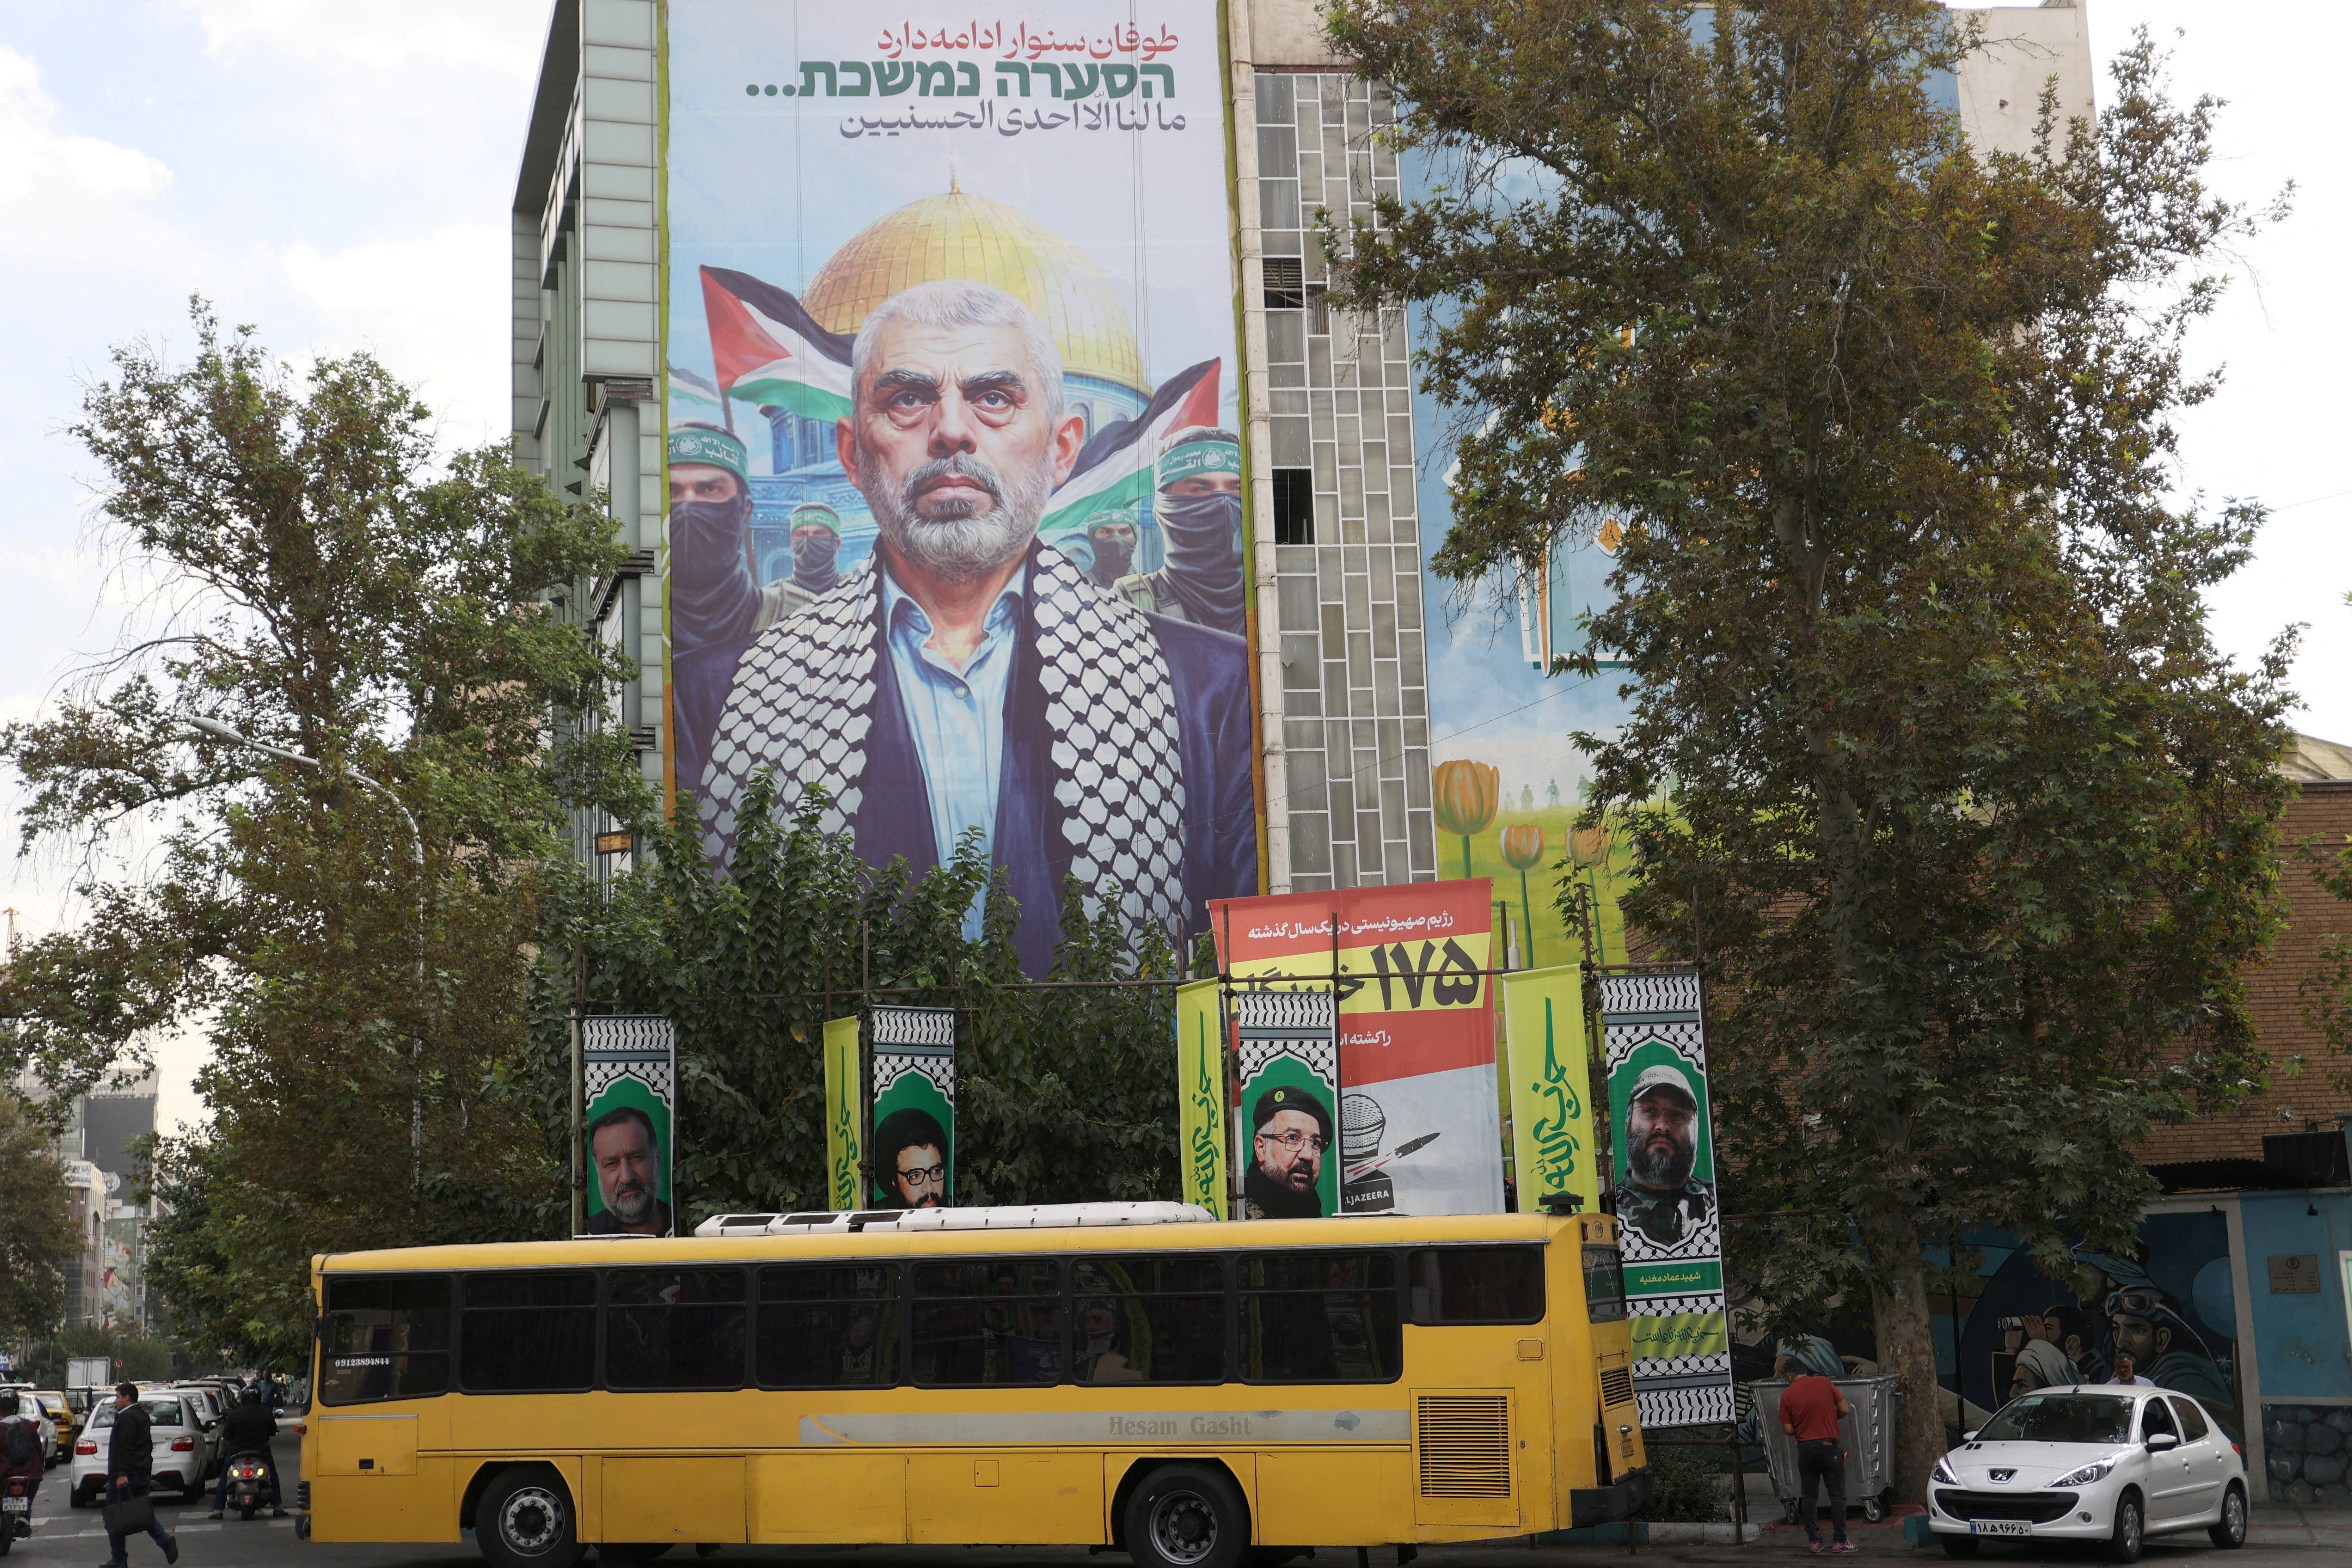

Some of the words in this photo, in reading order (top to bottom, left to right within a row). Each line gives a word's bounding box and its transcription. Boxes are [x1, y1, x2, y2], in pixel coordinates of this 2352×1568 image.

[877, 20, 928, 59] دارد
[930, 19, 1001, 49] ادامه
[1002, 20, 1086, 59] سنوار
[1089, 21, 1179, 61] طوفان
[995, 60, 1176, 101] הסערה
[1115, 101, 1149, 131] لنا
[1156, 101, 1186, 131] ما
[1248, 922, 1289, 938] گذشته
[1351, 916, 1426, 934] صهیونیستی
[1427, 910, 1454, 931] رژیم
[1370, 937, 1480, 1011] ۱۷۵
[1345, 1190, 1390, 1206] LJAZEERA
[1109, 1416, 1179, 1435] Hesam
[1190, 1416, 1253, 1436] Gasht
